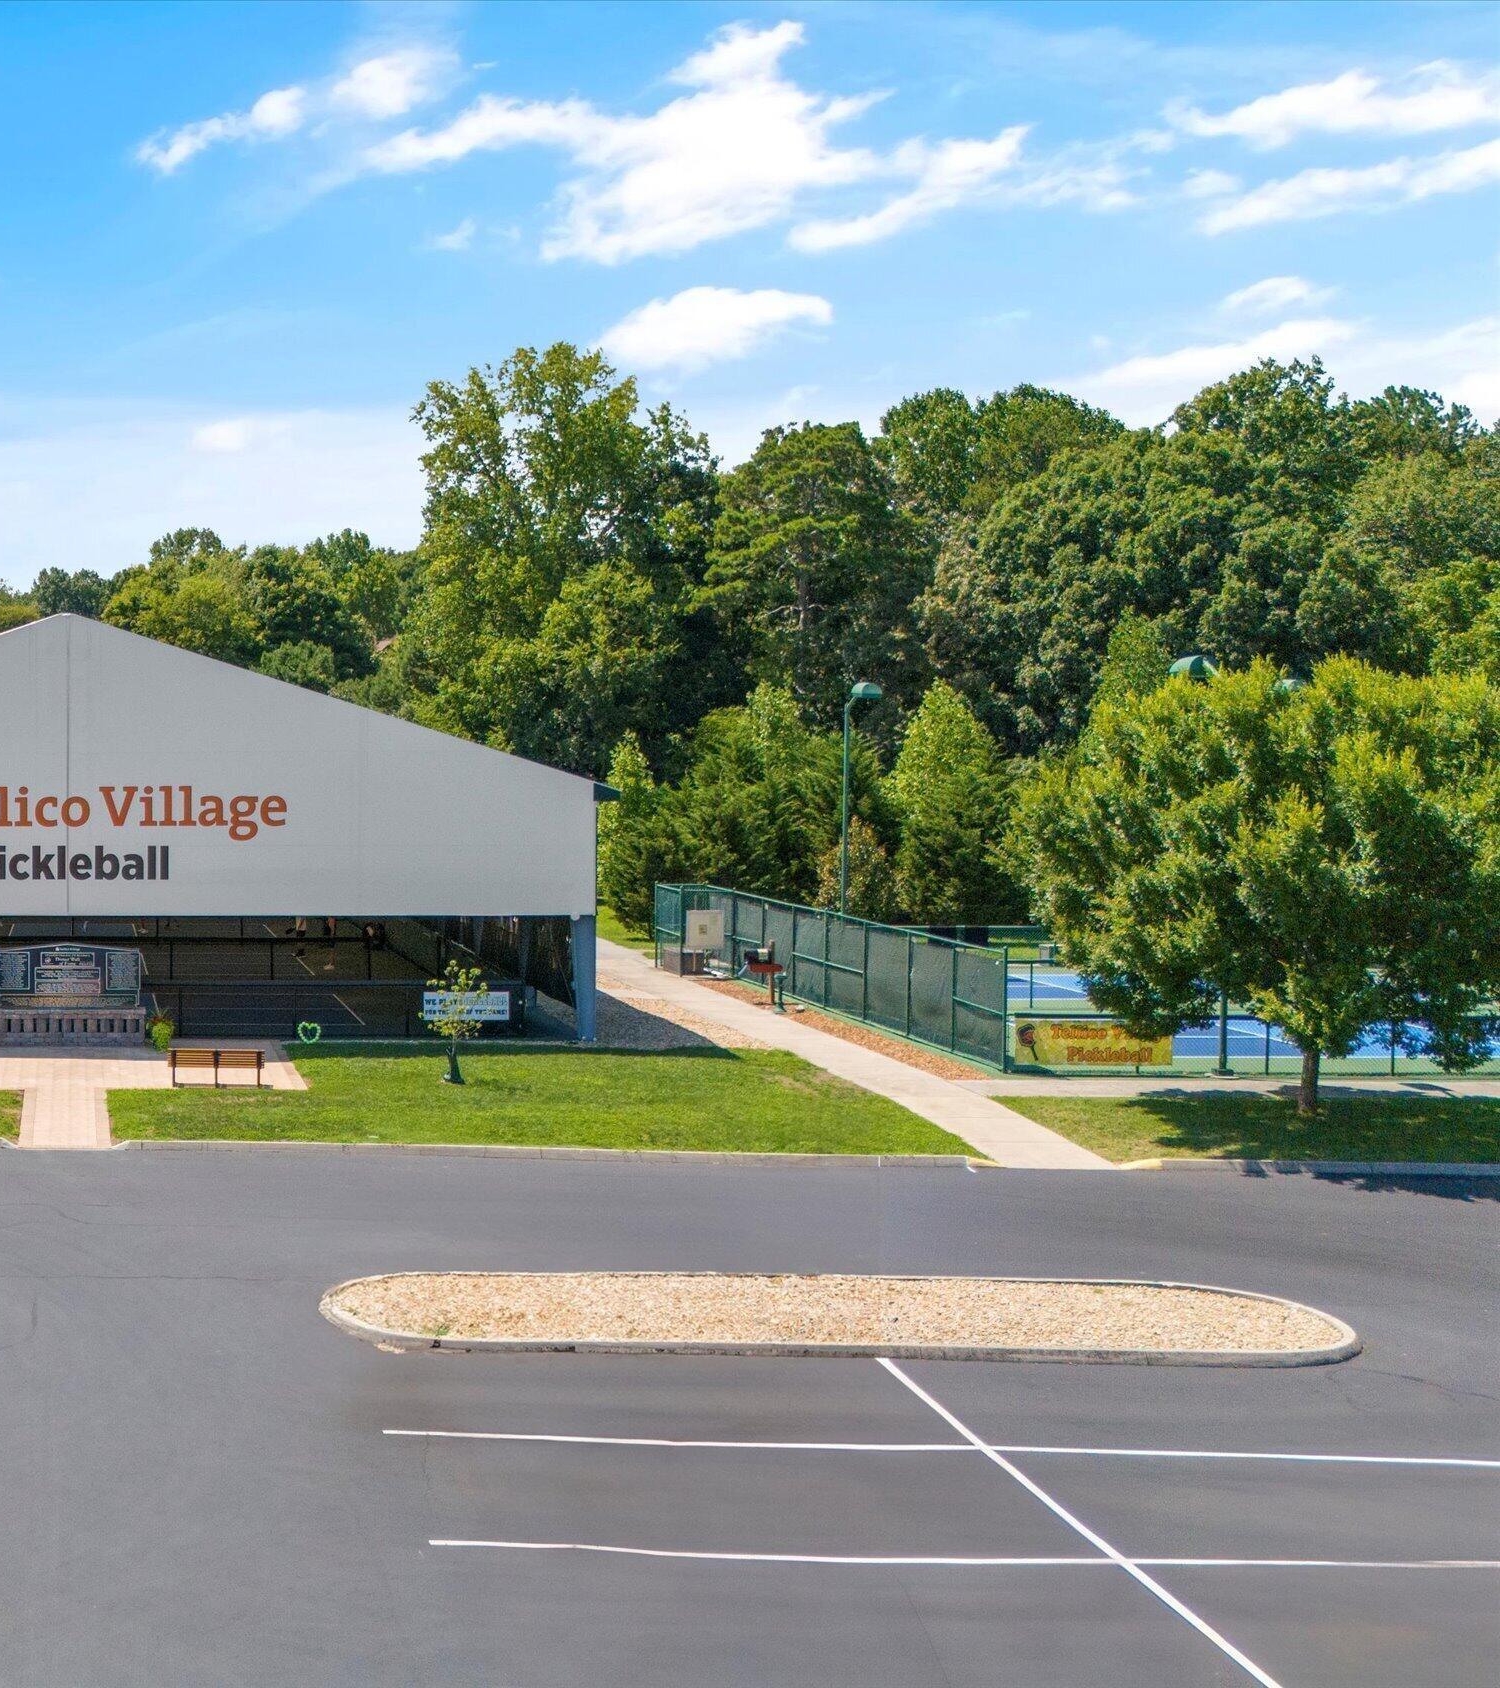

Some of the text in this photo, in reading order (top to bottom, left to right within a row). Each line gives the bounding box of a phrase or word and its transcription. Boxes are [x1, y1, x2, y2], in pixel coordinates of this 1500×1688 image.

[99, 785, 288, 841] Village
[1050, 1023, 1108, 1040] Tellico
[1066, 1046, 1153, 1063] Pickleball
